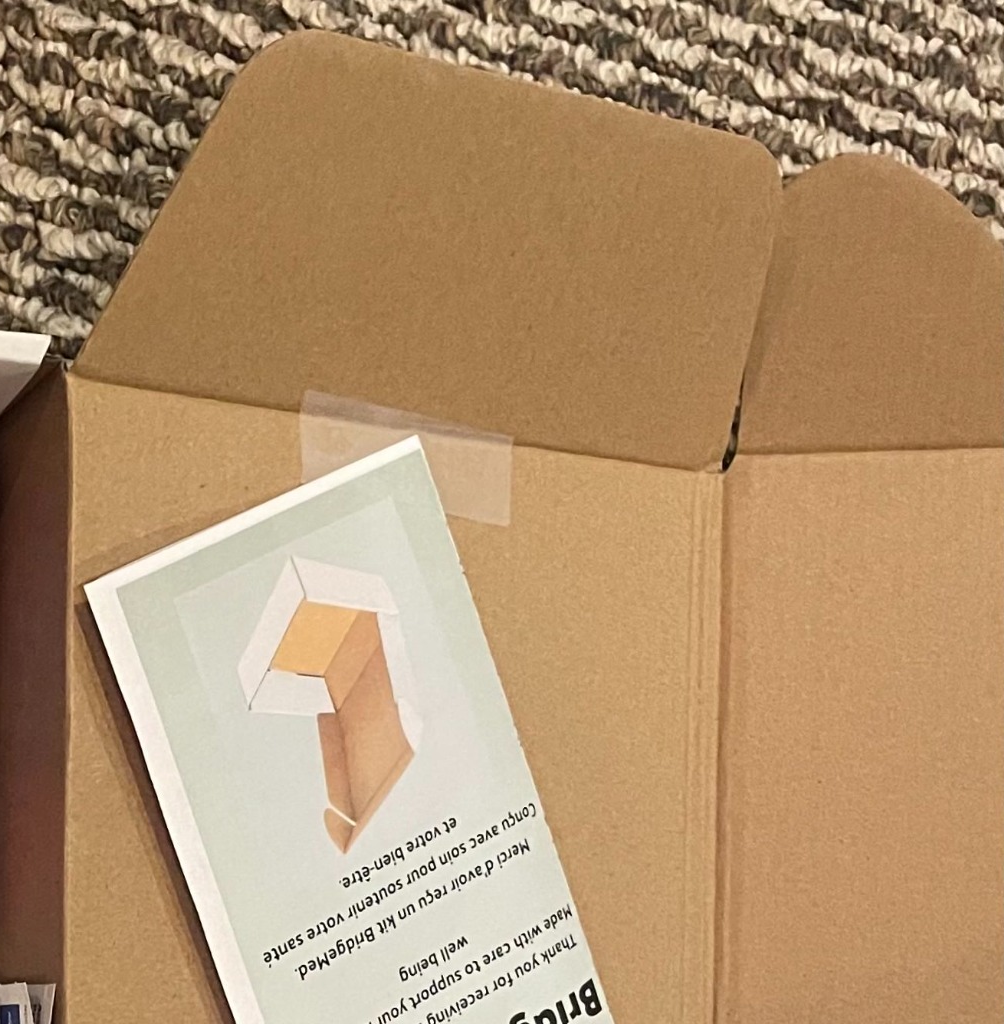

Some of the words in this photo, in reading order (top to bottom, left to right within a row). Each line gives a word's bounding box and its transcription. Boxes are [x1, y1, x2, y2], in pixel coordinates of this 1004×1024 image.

[441, 817, 457, 834] et
[501, 802, 537, 831] Conçu
[405, 826, 442, 853] votre
[468, 824, 500, 850] avec
[438, 842, 468, 866] soin
[496, 838, 531, 869] Merci
[338, 846, 406, 889] bien-être.
[406, 855, 437, 886] pour
[450, 859, 495, 892] d'avoir
[347, 878, 404, 919] soutenir
[417, 884, 449, 909] reçu
[376, 914, 397, 935] kit
[397, 903, 417, 921] un
[543, 904, 574, 930] Made
[305, 912, 346, 940] votre
[513, 924, 543, 949] with
[262, 933, 305, 969] santé
[294, 926, 376, 982] BridgeMed.
[439, 935, 469, 963] well
[481, 942, 512, 966] care
[539, 933, 578, 965] Thank
[398, 952, 440, 983] being
[464, 960, 482, 975] to
[514, 952, 541, 979] you
[408, 969, 463, 1010] support
[492, 972, 514, 992] for
